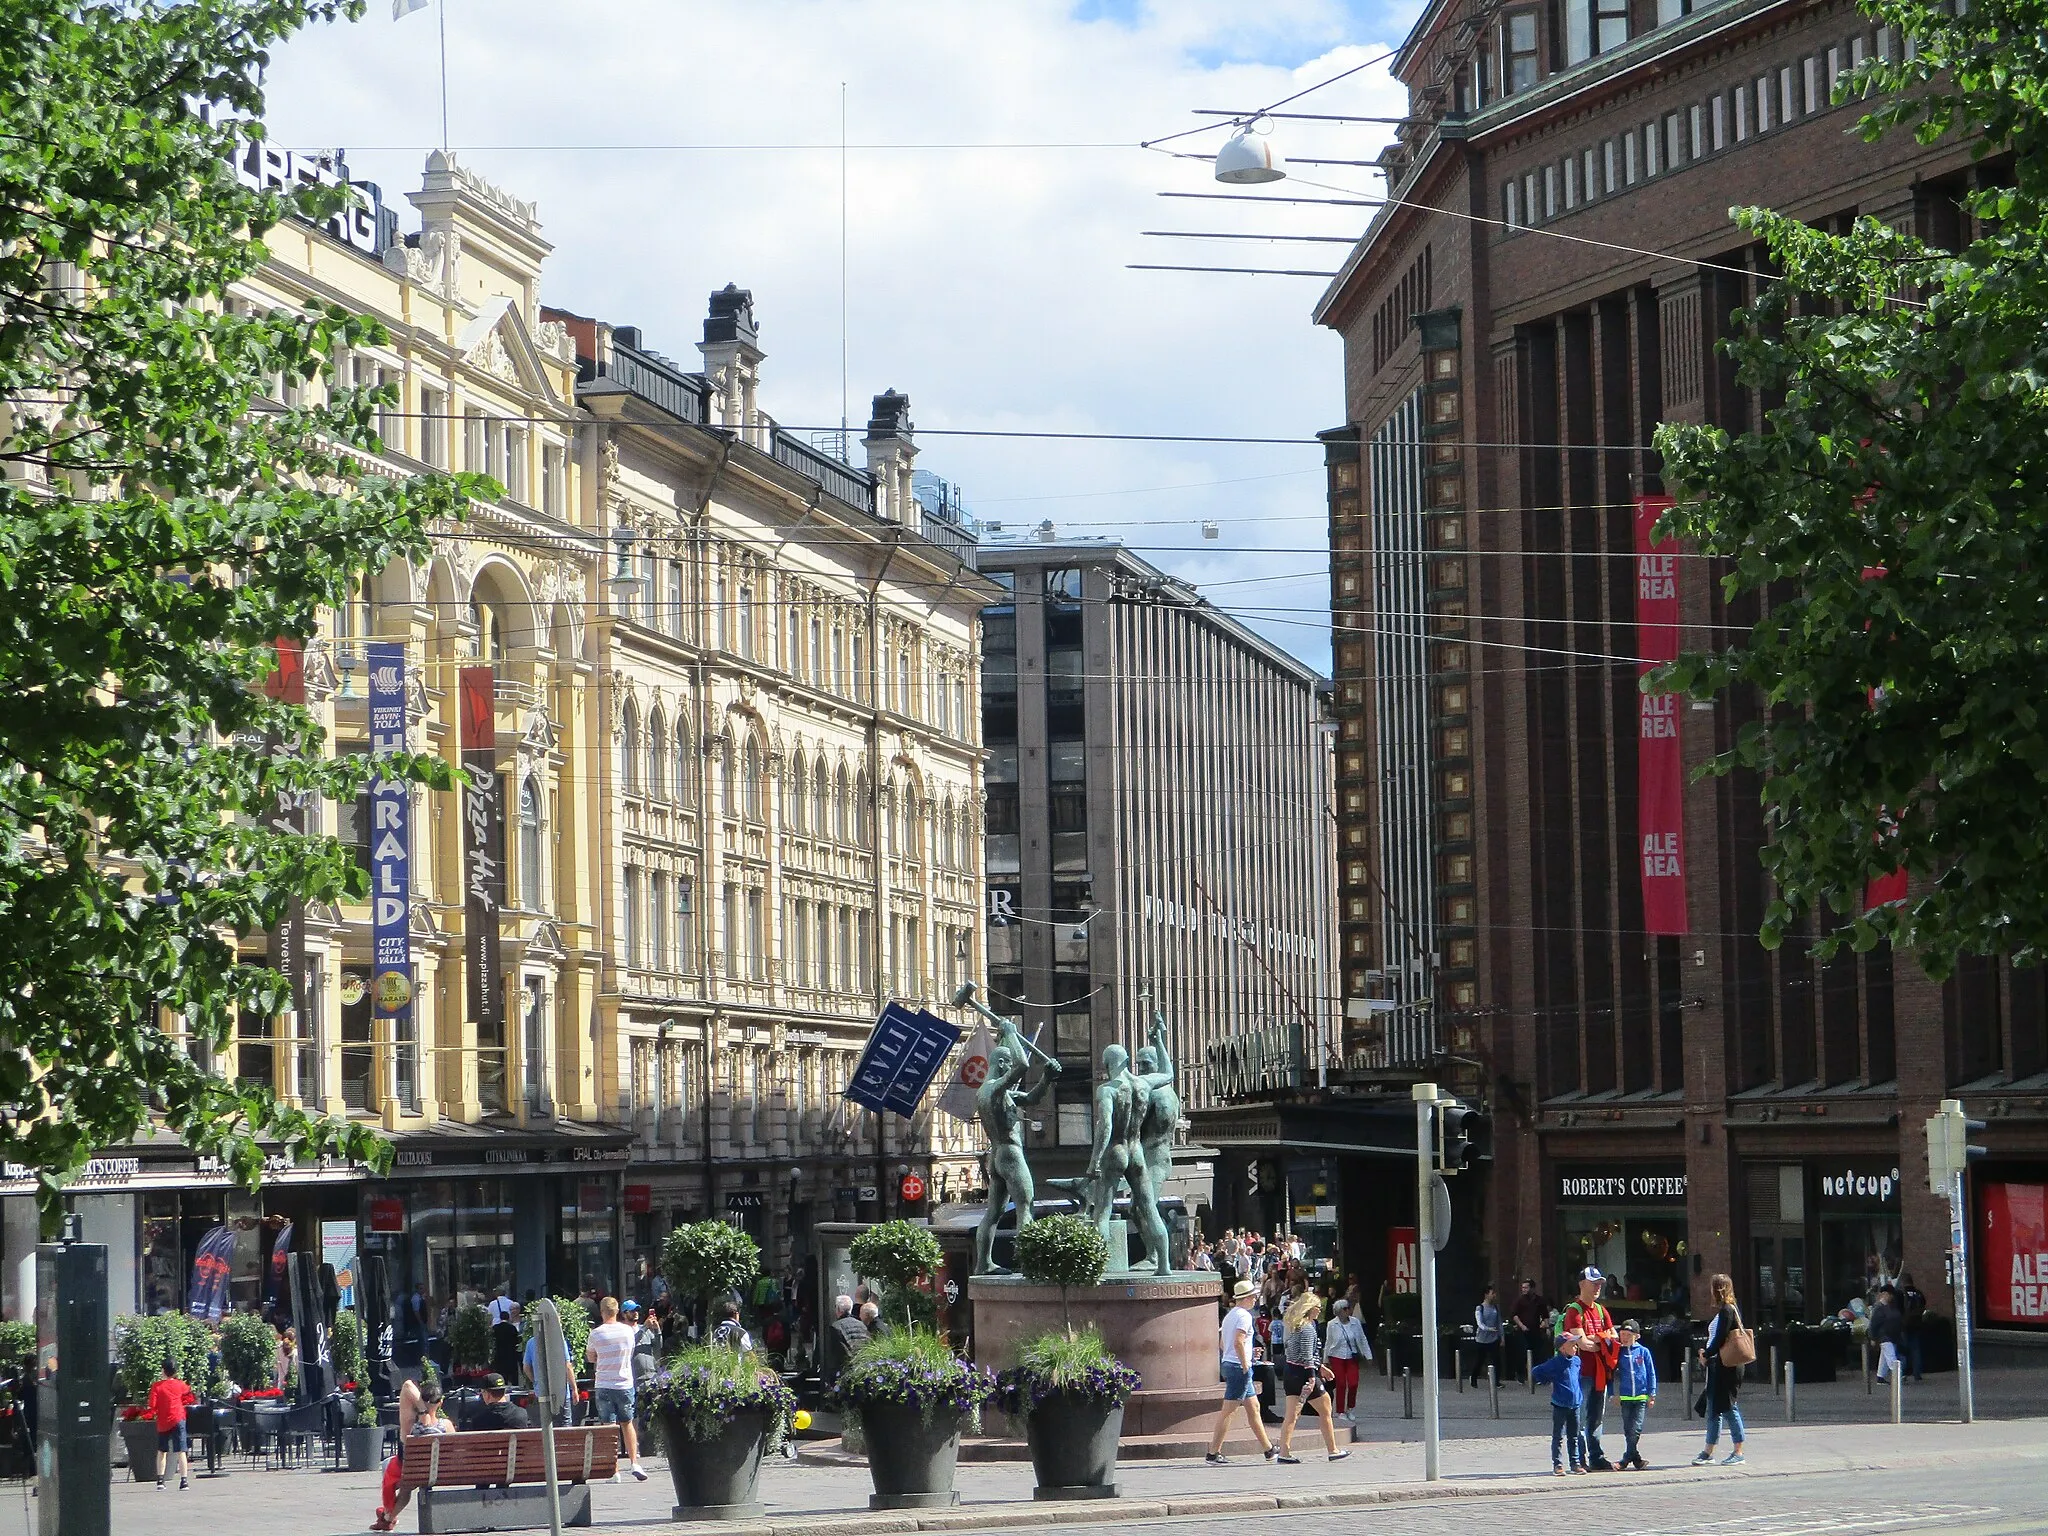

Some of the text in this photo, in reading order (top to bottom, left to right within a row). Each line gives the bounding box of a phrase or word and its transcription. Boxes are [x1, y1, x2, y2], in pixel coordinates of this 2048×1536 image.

[1639, 557, 1674, 576] ALE
[1640, 579, 1676, 599] REA
[1642, 694, 1674, 716] ALE
[374, 720, 401, 729] TOLA
[1641, 717, 1677, 738] REA
[464, 762, 494, 846] Pizza
[373, 733, 407, 926] HARALD
[1643, 833, 1678, 855] ALE
[1645, 856, 1681, 877] REA
[470, 849, 496, 912] Hut
[1146, 895, 1197, 931] WORLD
[1268, 927, 1315, 959] CENTER
[378, 937, 405, 947] CITY-
[378, 954, 406, 964] VÄLLÄ
[479, 935, 491, 1015] www.pizzahut.fi
[862, 1028, 908, 1085] EVLI
[896, 1036, 938, 1094] EVLI
[105, 1157, 139, 1174] COFFEE
[1562, 1178, 1626, 1196] ROBERT'S
[2011, 1253, 2048, 1284] ALE
